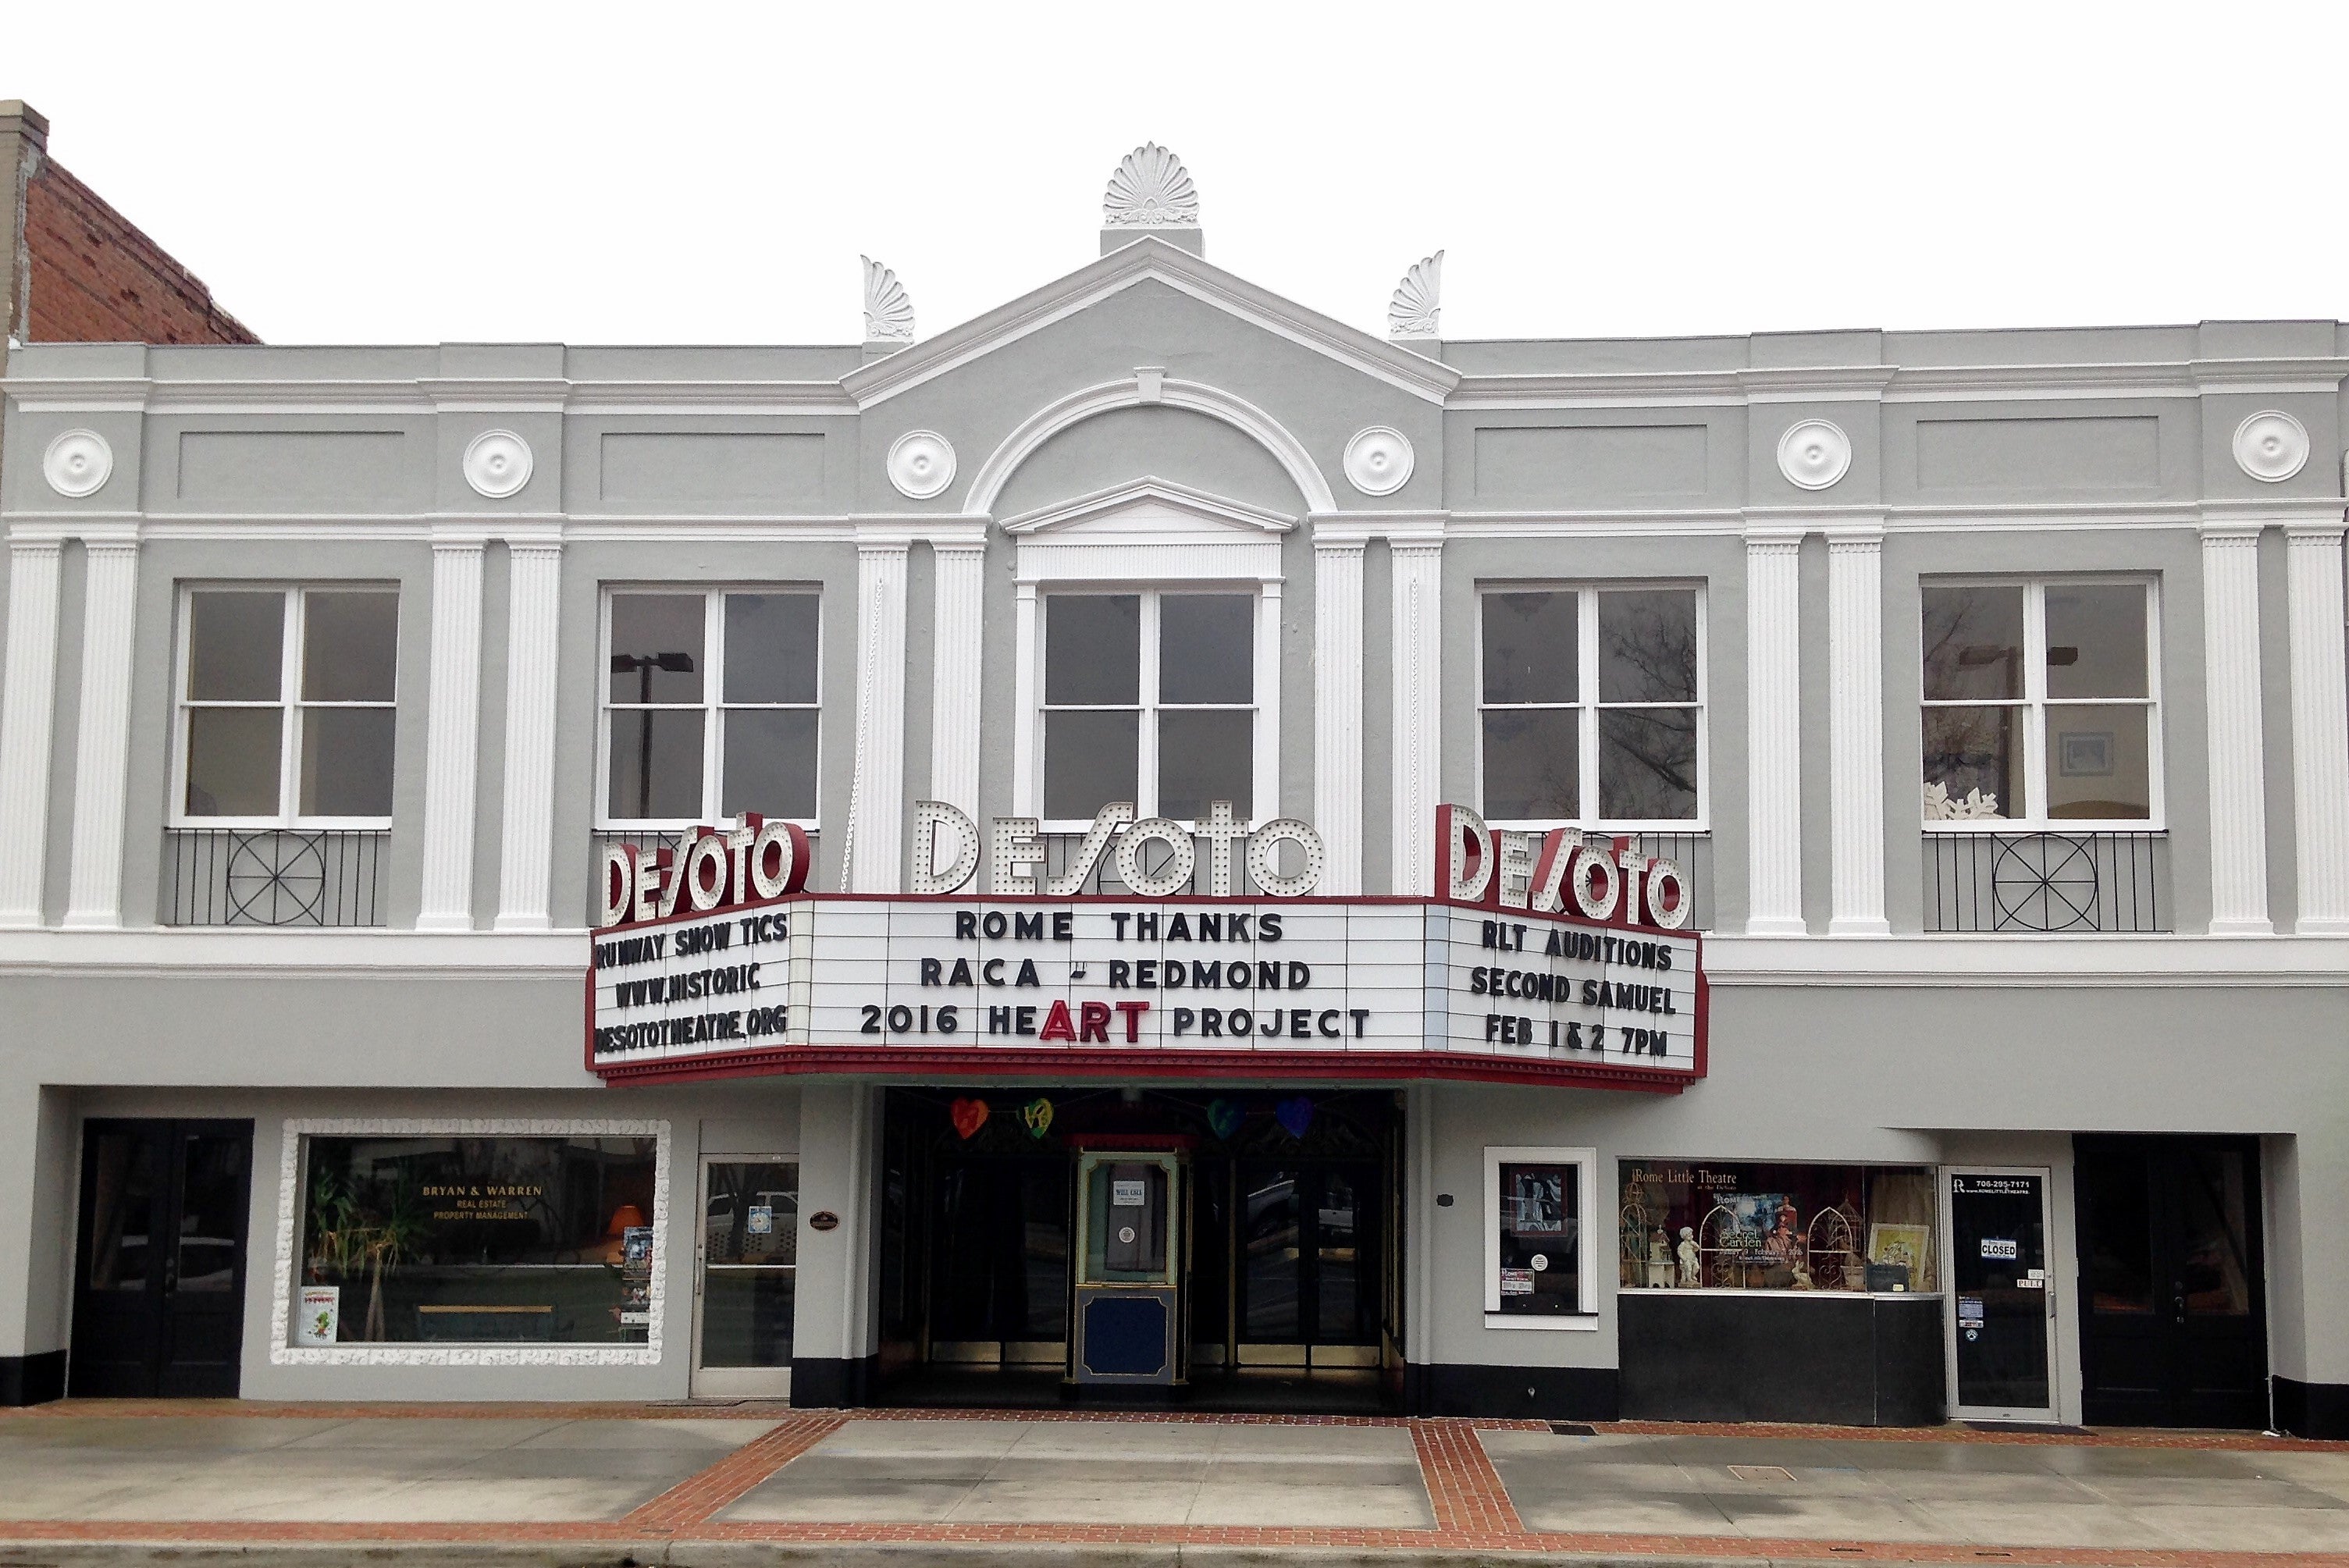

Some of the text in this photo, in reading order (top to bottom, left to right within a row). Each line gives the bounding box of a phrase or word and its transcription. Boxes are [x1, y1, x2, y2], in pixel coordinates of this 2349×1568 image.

[595, 913, 787, 969] RUNWAY SHOW TICS
[956, 911, 1283, 943] ROME THANKS
[1482, 919, 1672, 971] RLT AUDITIONS
[616, 962, 760, 1008] WWW.HISTORIC
[921, 958, 1041, 987] RACA
[1109, 959, 1311, 990] REDMOND
[1471, 966, 1676, 1015] SECOND SAMUEL
[861, 1000, 1369, 1043] 2016 HEART PROJECT
[1486, 1014, 1667, 1057] FEB 1 & 2 7PM
[422, 1186, 543, 1196] BRYAN & WARREN
[1632, 1168, 1737, 1184] Rome Little Theatre
[433, 1211, 528, 1220] PROPERTY MANAGEMENT
[457, 1200, 507, 1208] REAL ESTATE
[1720, 1236, 1762, 1247] Garden
[1982, 1245, 2016, 1255] CLOSED
